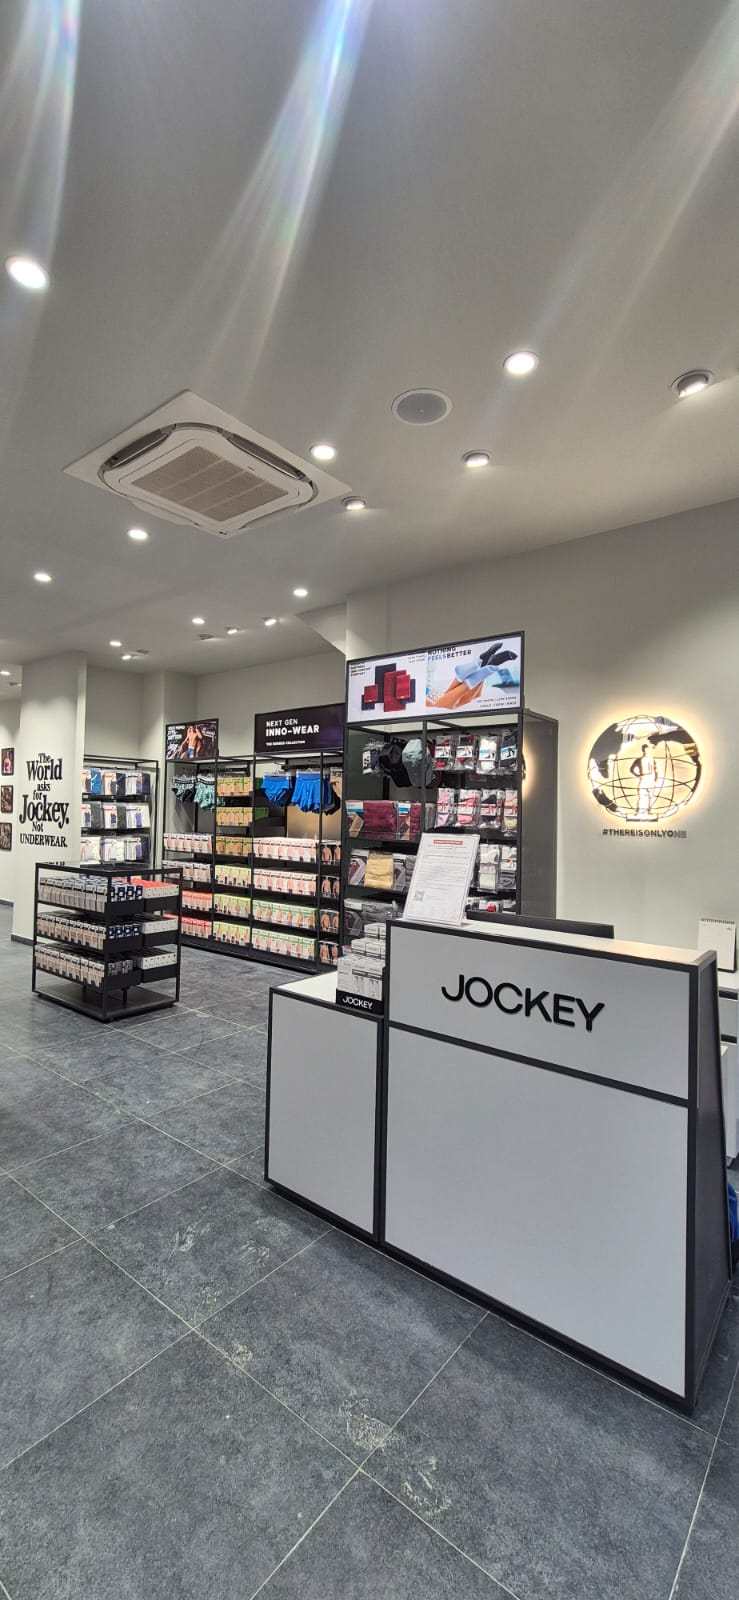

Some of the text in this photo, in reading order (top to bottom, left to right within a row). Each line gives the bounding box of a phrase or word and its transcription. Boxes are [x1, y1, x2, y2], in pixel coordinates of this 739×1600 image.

[428, 646, 456, 655] NOTHING
[266, 724, 320, 736] INNO-WEAR
[38, 753, 50, 764] The
[26, 758, 62, 780] World
[36, 781, 50, 792] asks
[33, 790, 42, 800] for
[19, 794, 69, 829] Jockey.
[32, 822, 44, 832] Not
[602, 828, 687, 838] #THEREISONLYONE
[20, 834, 68, 848] UNDERWEAR.
[342, 996, 373, 1010] JOCKEY
[441, 974, 605, 1032] JOCKEY
